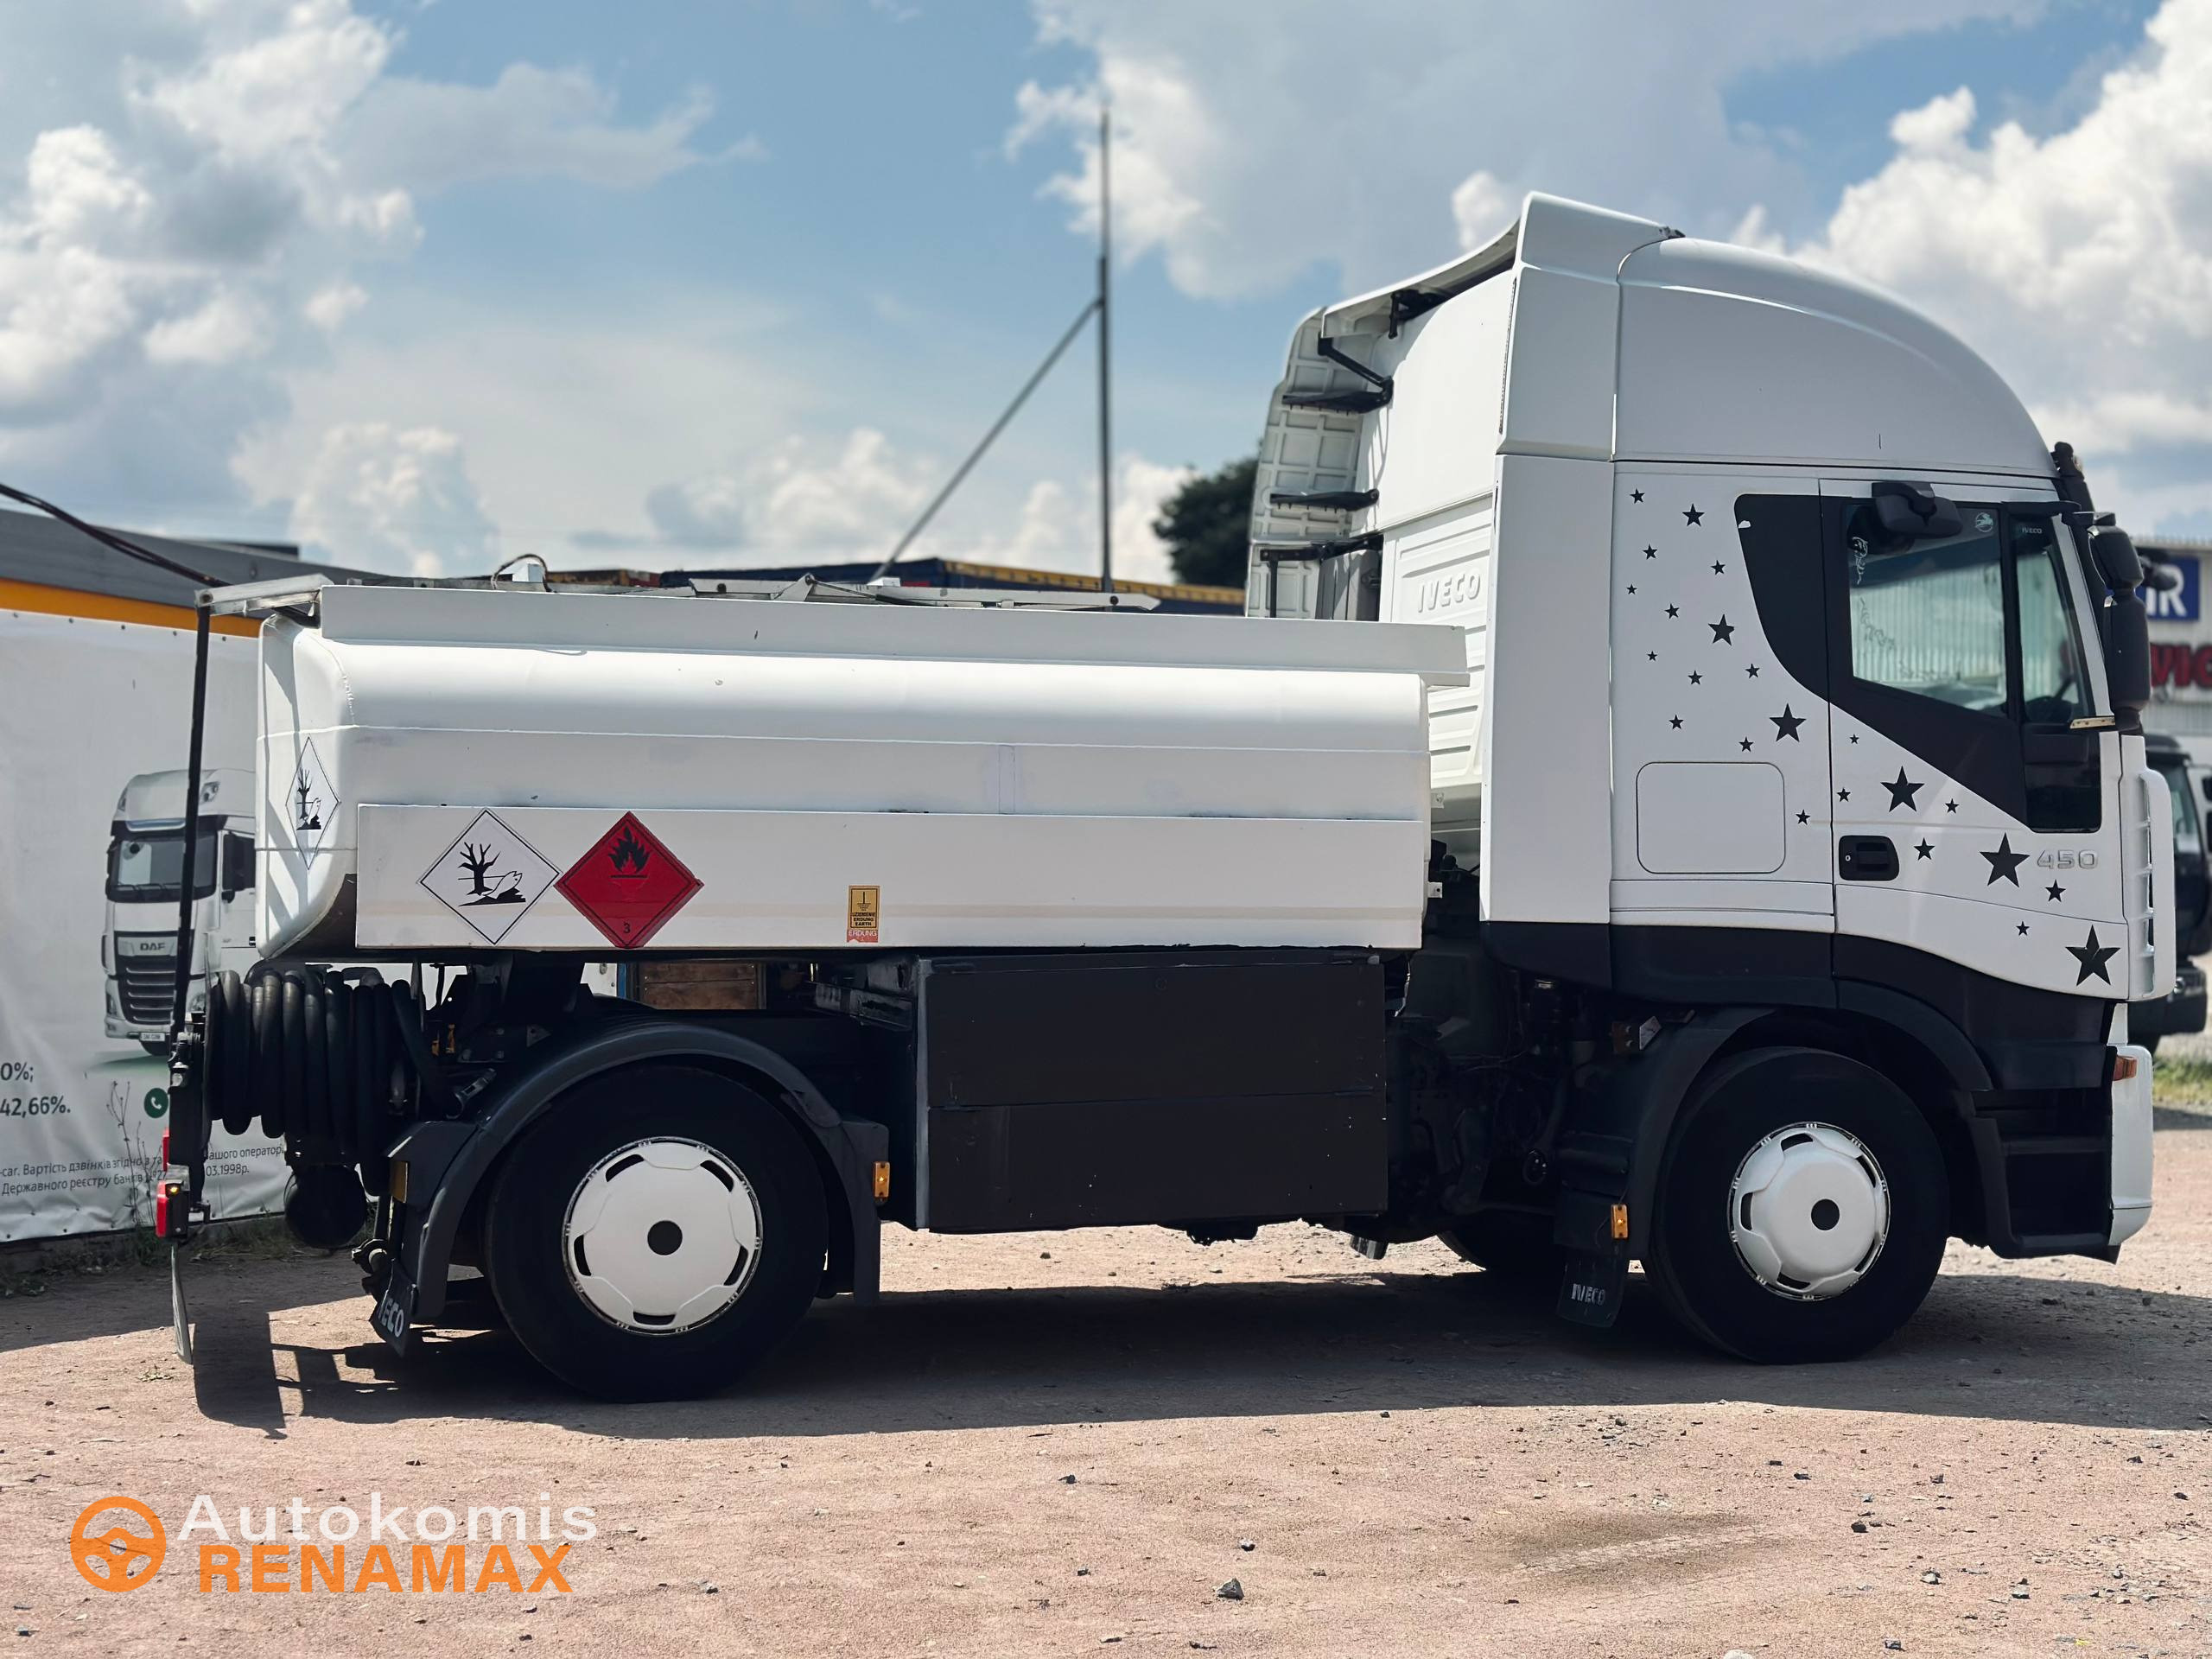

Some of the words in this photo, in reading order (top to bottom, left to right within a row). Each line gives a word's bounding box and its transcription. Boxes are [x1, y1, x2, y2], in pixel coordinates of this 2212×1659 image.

[1417, 573, 1481, 613] IVECO
[2037, 849, 2099, 870] 450
[623, 923, 631, 934] 3
[140, 943, 166, 951] DAF
[0, 1095, 71, 1118] 42,66%.
[23, 1163, 67, 1176] Вартість
[208, 1150, 238, 1160] ашого
[2, 1181, 67, 1196] Державного
[70, 1176, 111, 1191] реєстру
[1571, 1283, 1606, 1306] IVECO
